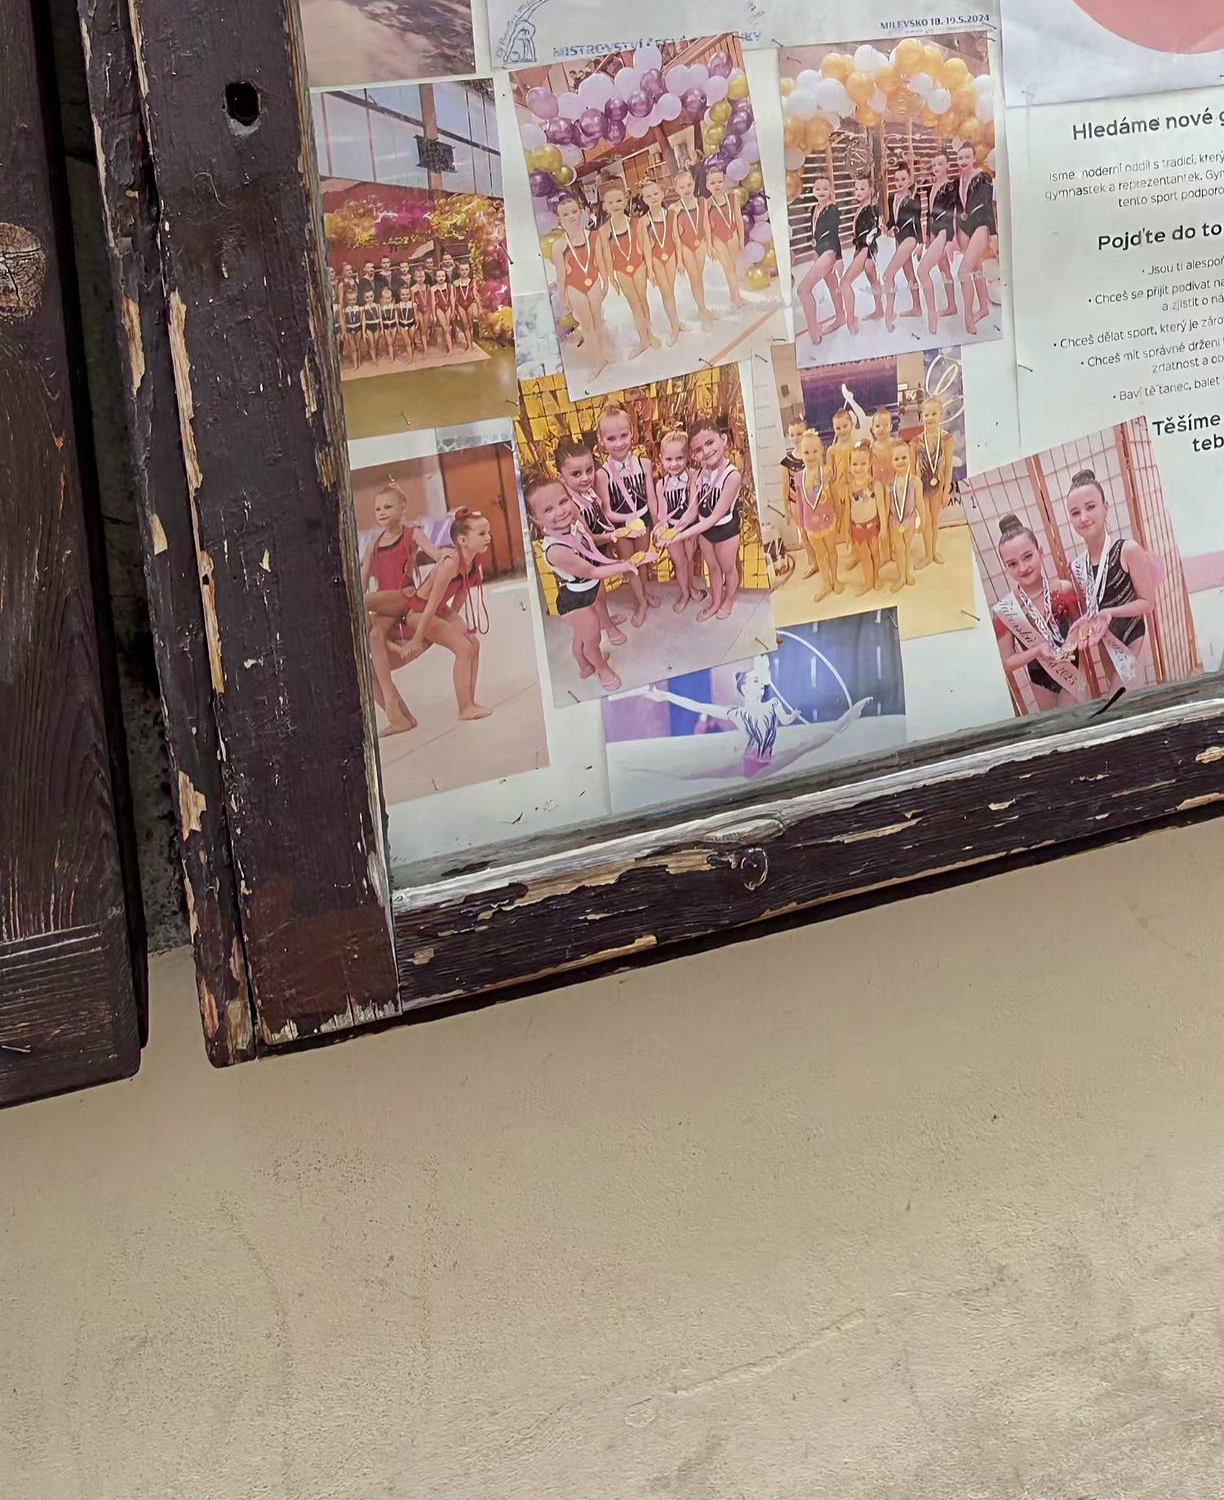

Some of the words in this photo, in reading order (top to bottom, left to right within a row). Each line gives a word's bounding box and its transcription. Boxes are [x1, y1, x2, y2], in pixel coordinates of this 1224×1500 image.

[880, 18, 928, 30] MILEVSKO
[1072, 117, 1160, 140] Hledáme
[1165, 107, 1213, 129] nové
[1153, 160, 1159, 169] s
[1199, 150, 1224, 164] který
[1045, 183, 1106, 201] gymnastek
[1108, 183, 1115, 192] a
[1118, 195, 1148, 207] tento
[1151, 192, 1178, 205] sport
[1098, 228, 1166, 251] Pojďte
[1172, 225, 1196, 241] do
[1149, 264, 1174, 275] Jsou
[1095, 290, 1128, 305] Chceš
[1131, 290, 1144, 299] se
[1172, 280, 1210, 295] podívat
[1162, 302, 1168, 311] a
[1201, 297, 1208, 305] o
[1060, 334, 1094, 349] Chceš
[1097, 330, 1124, 344] dělat
[1127, 326, 1157, 342] sport,
[1160, 319, 1187, 333] který
[1189, 319, 1199, 332] je
[1087, 352, 1121, 367] Chceš
[1143, 343, 1185, 359] správné
[1152, 358, 1199, 374] zdatnost
[1202, 356, 1209, 365] a
[1119, 387, 1142, 401] Baví
[1159, 382, 1192, 395] tanec,
[1194, 377, 1220, 389] balet
[1152, 413, 1221, 437] Těšíme
